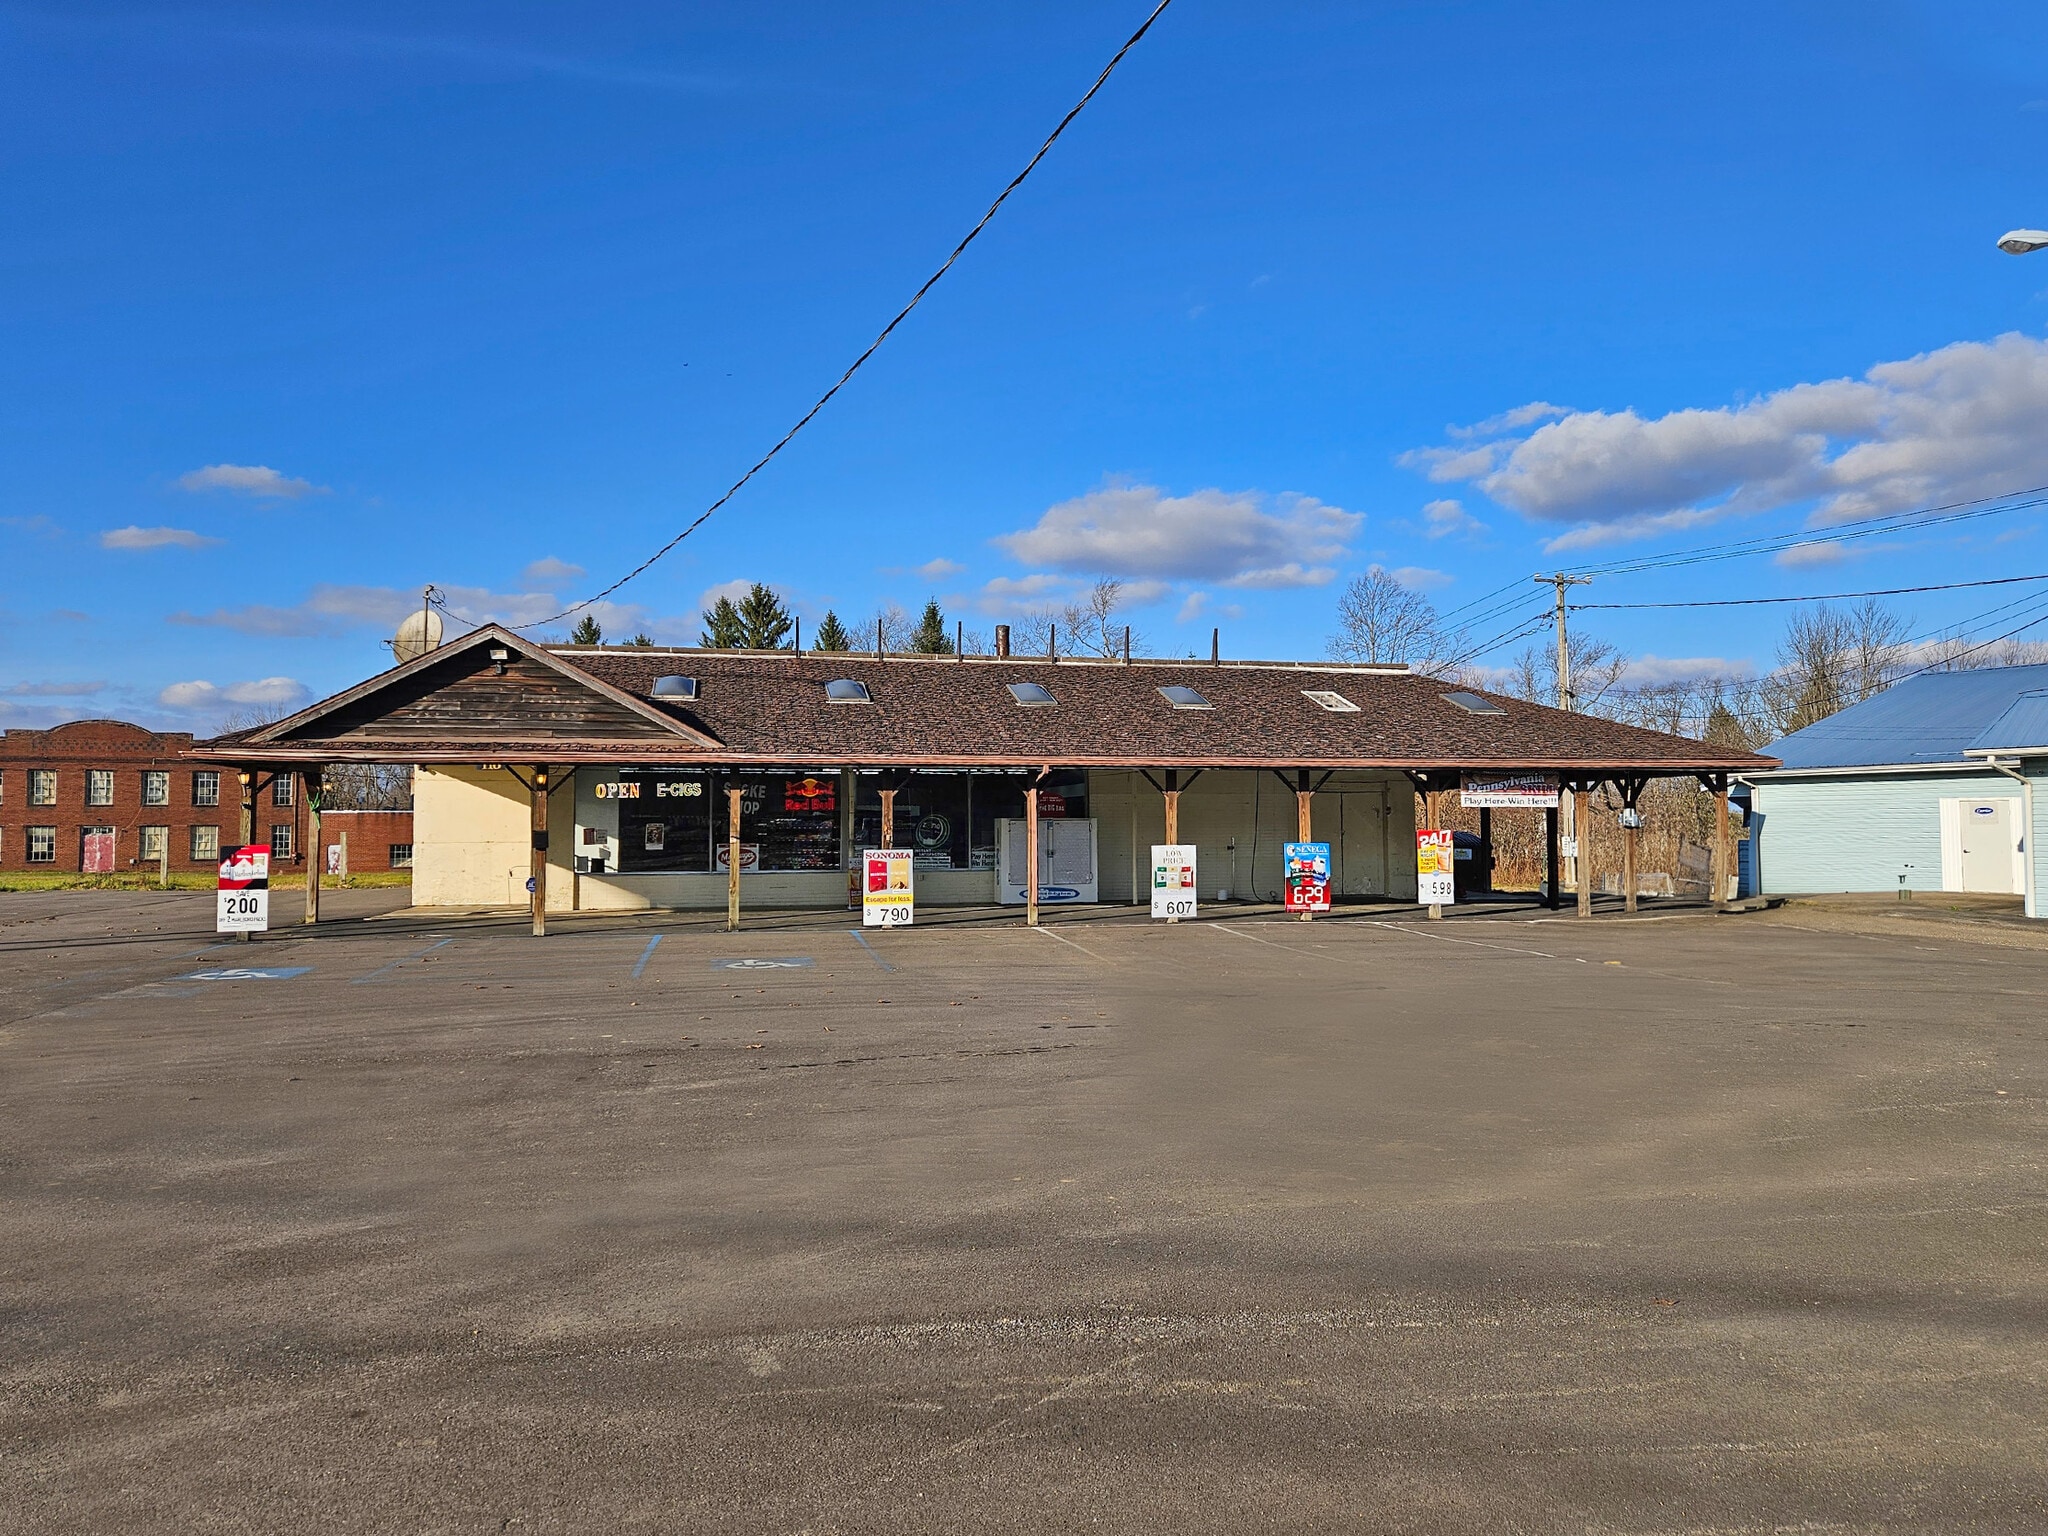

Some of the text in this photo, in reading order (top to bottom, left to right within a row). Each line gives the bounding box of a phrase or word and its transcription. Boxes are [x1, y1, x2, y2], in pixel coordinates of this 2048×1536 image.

[1468, 772, 1545, 792] Pennsylvania
[595, 783, 640, 798] OPEN
[656, 783, 702, 797] E-CIGS
[723, 782, 766, 798] SOKE
[785, 797, 835, 811] Red Bull
[1464, 797, 1482, 805] Play
[1527, 797, 1557, 805] Here!!!
[865, 852, 911, 860] SONOMA
[1296, 845, 1328, 853] SENECA
